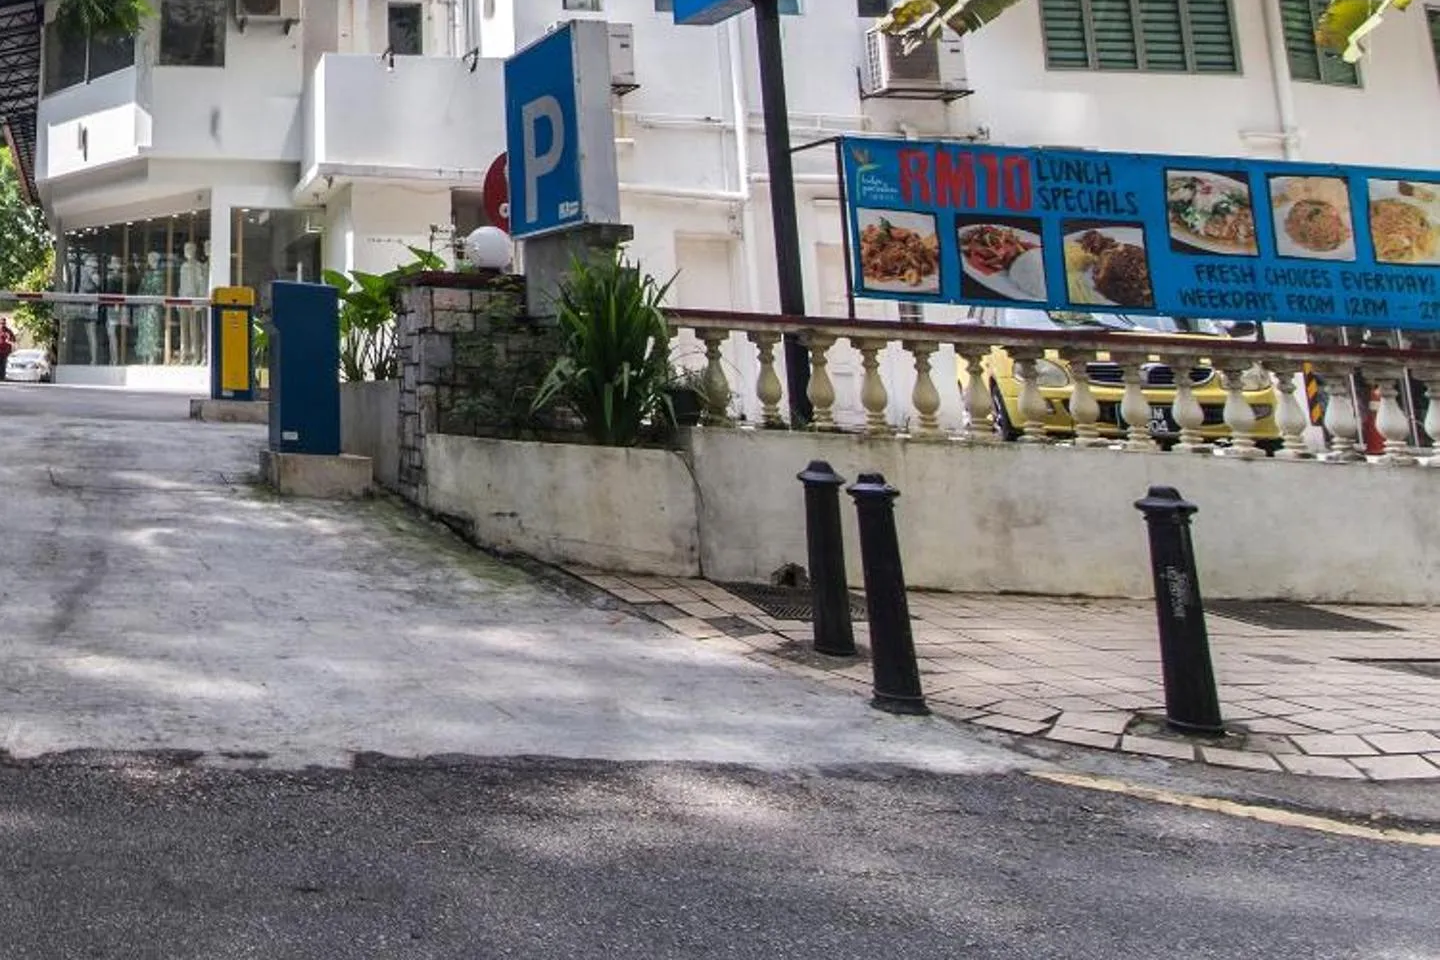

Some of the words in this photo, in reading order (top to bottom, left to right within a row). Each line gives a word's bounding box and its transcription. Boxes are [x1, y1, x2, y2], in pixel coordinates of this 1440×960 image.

[521, 94, 565, 224] P
[1036, 156, 1113, 186] LUNCH
[897, 148, 1032, 212] RM10
[1037, 186, 1139, 216] SPECIALS
[1194, 263, 1256, 285] FRESH
[1264, 265, 1331, 288] CHOICES
[1179, 287, 1279, 312] WEEKDAYS
[1286, 294, 1335, 316] FROM
